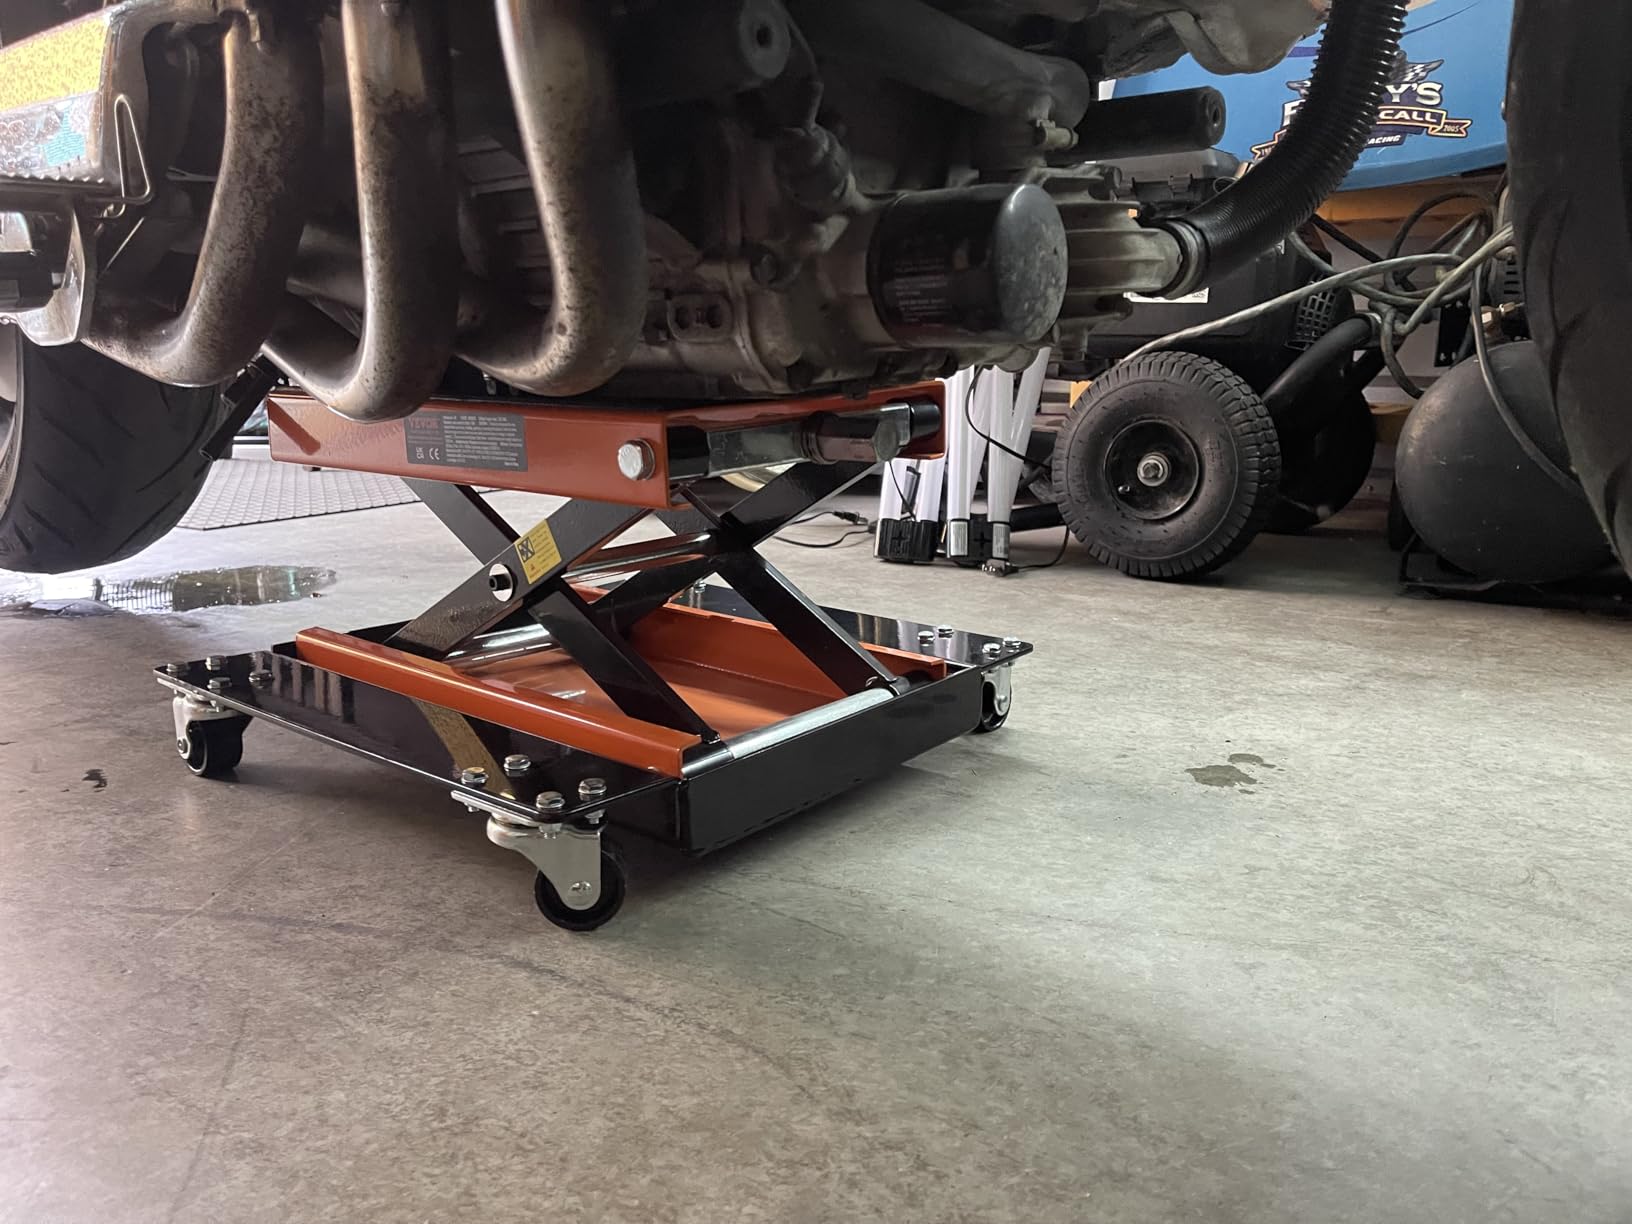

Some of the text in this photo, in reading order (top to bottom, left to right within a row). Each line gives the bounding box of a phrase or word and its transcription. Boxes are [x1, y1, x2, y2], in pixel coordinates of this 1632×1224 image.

[1384, 82, 1442, 105] Y'S
[1378, 110, 1437, 122] CALL
[1367, 135, 1401, 145] ACING
